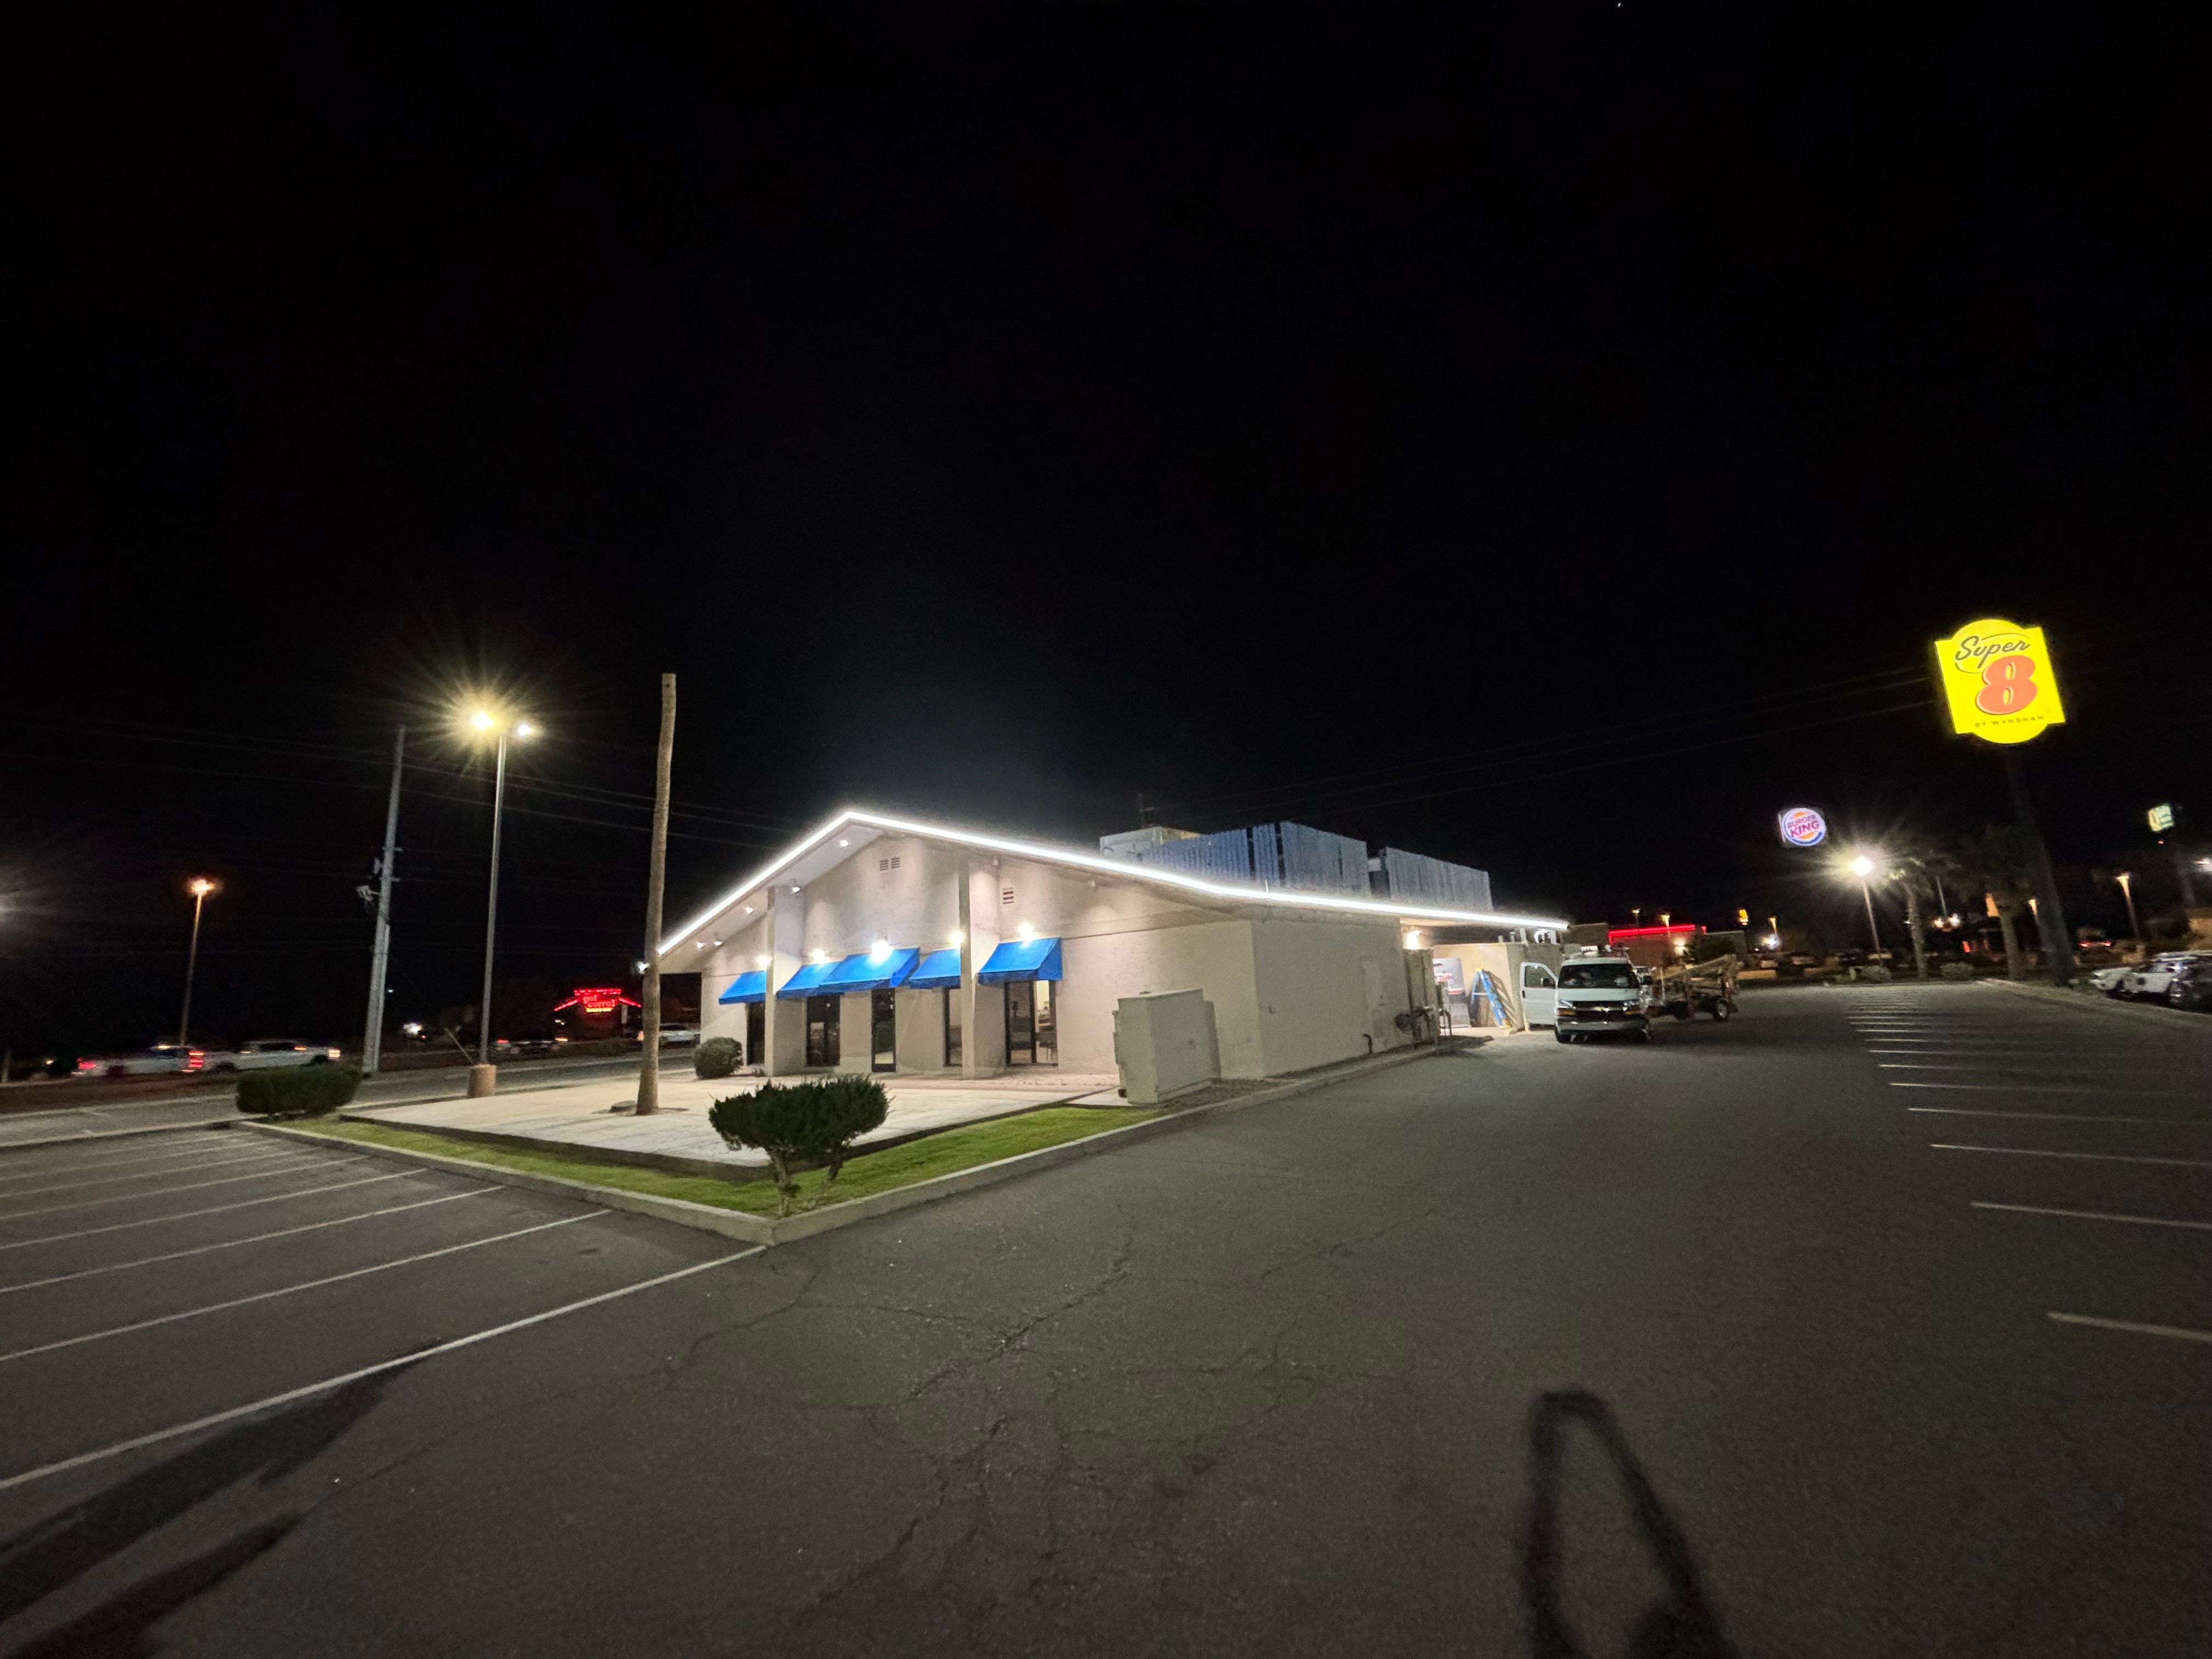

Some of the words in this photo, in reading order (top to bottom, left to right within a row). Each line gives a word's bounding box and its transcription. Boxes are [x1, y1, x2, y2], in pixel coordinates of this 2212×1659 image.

[1955, 635, 2030, 669] Super
[1975, 655, 2038, 715] 8
[1991, 715, 2044, 725] WYNDHAM
[1787, 814, 1817, 829] BURGER
[1790, 821, 1819, 837] KING
